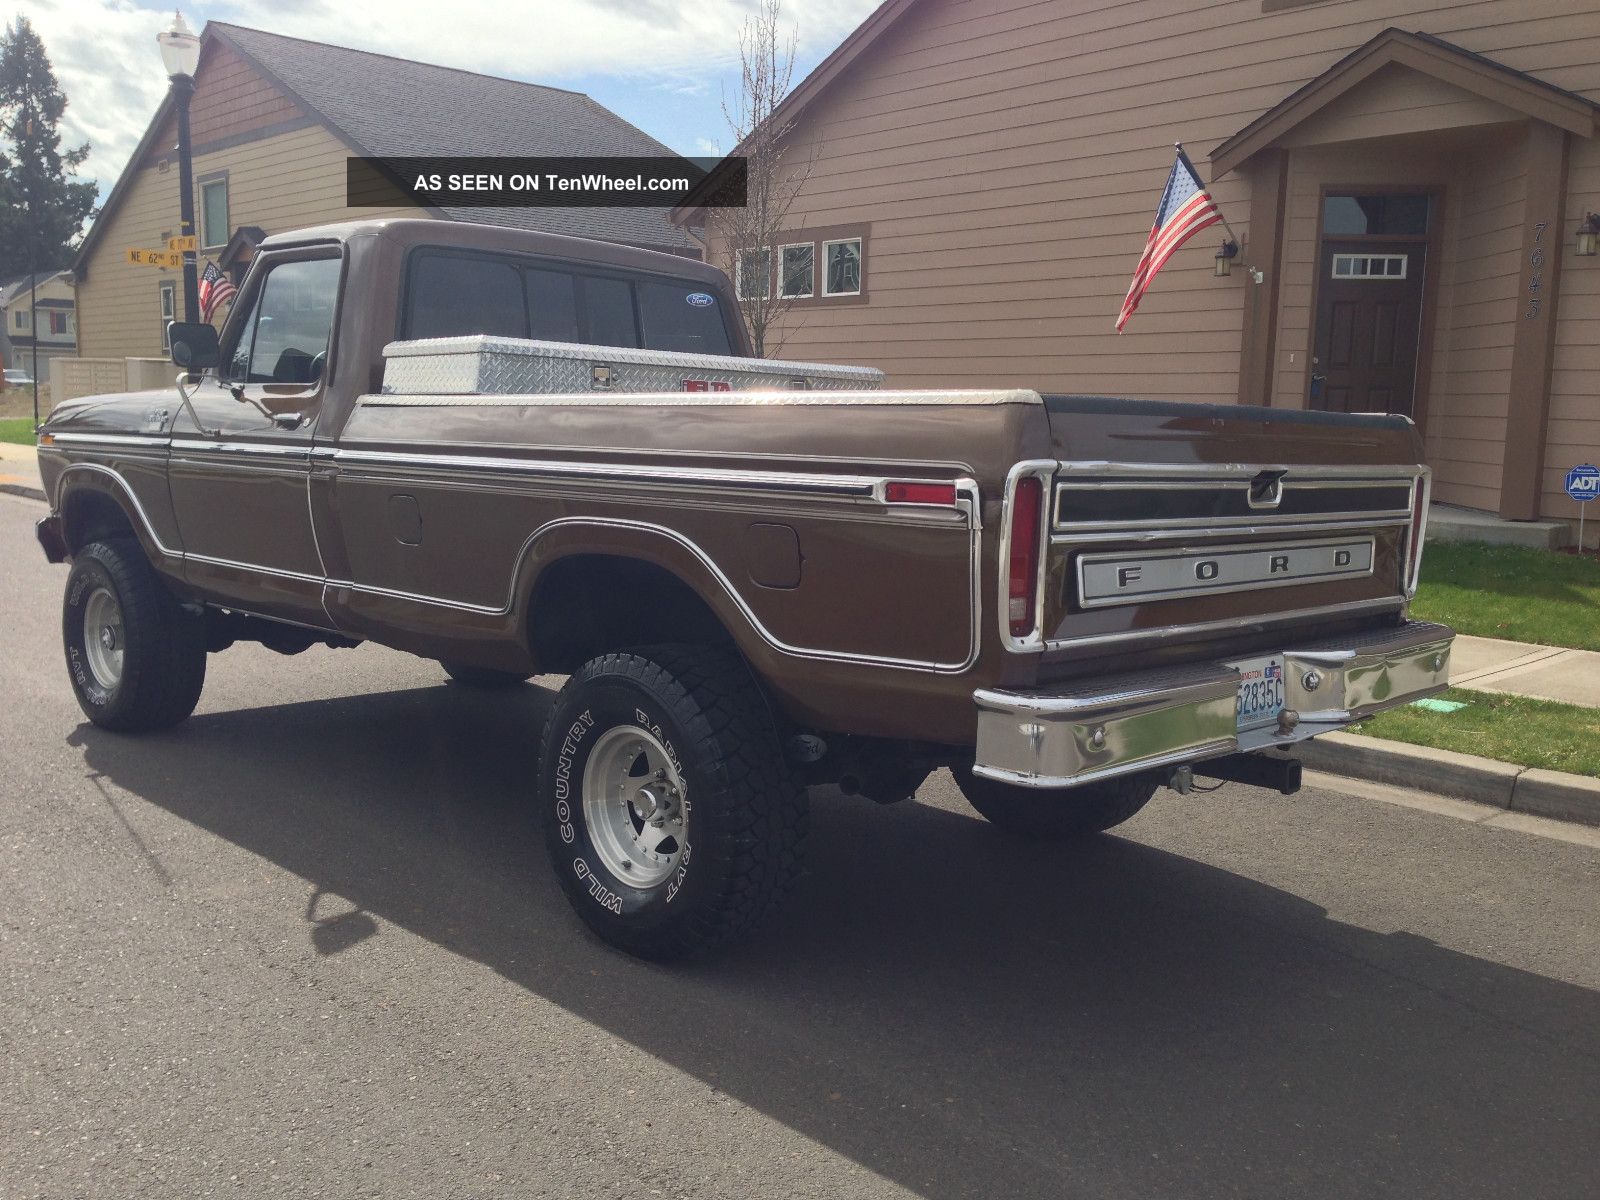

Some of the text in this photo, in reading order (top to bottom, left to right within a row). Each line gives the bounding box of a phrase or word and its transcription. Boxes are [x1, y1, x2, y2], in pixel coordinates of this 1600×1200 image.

[131, 251, 141, 262] NE
[170, 255, 178, 266] ST
[1570, 476, 1600, 490] ADT
[1117, 549, 1351, 588] FORD
[556, 709, 595, 843] COUNTRY
[573, 857, 623, 914] WILD
